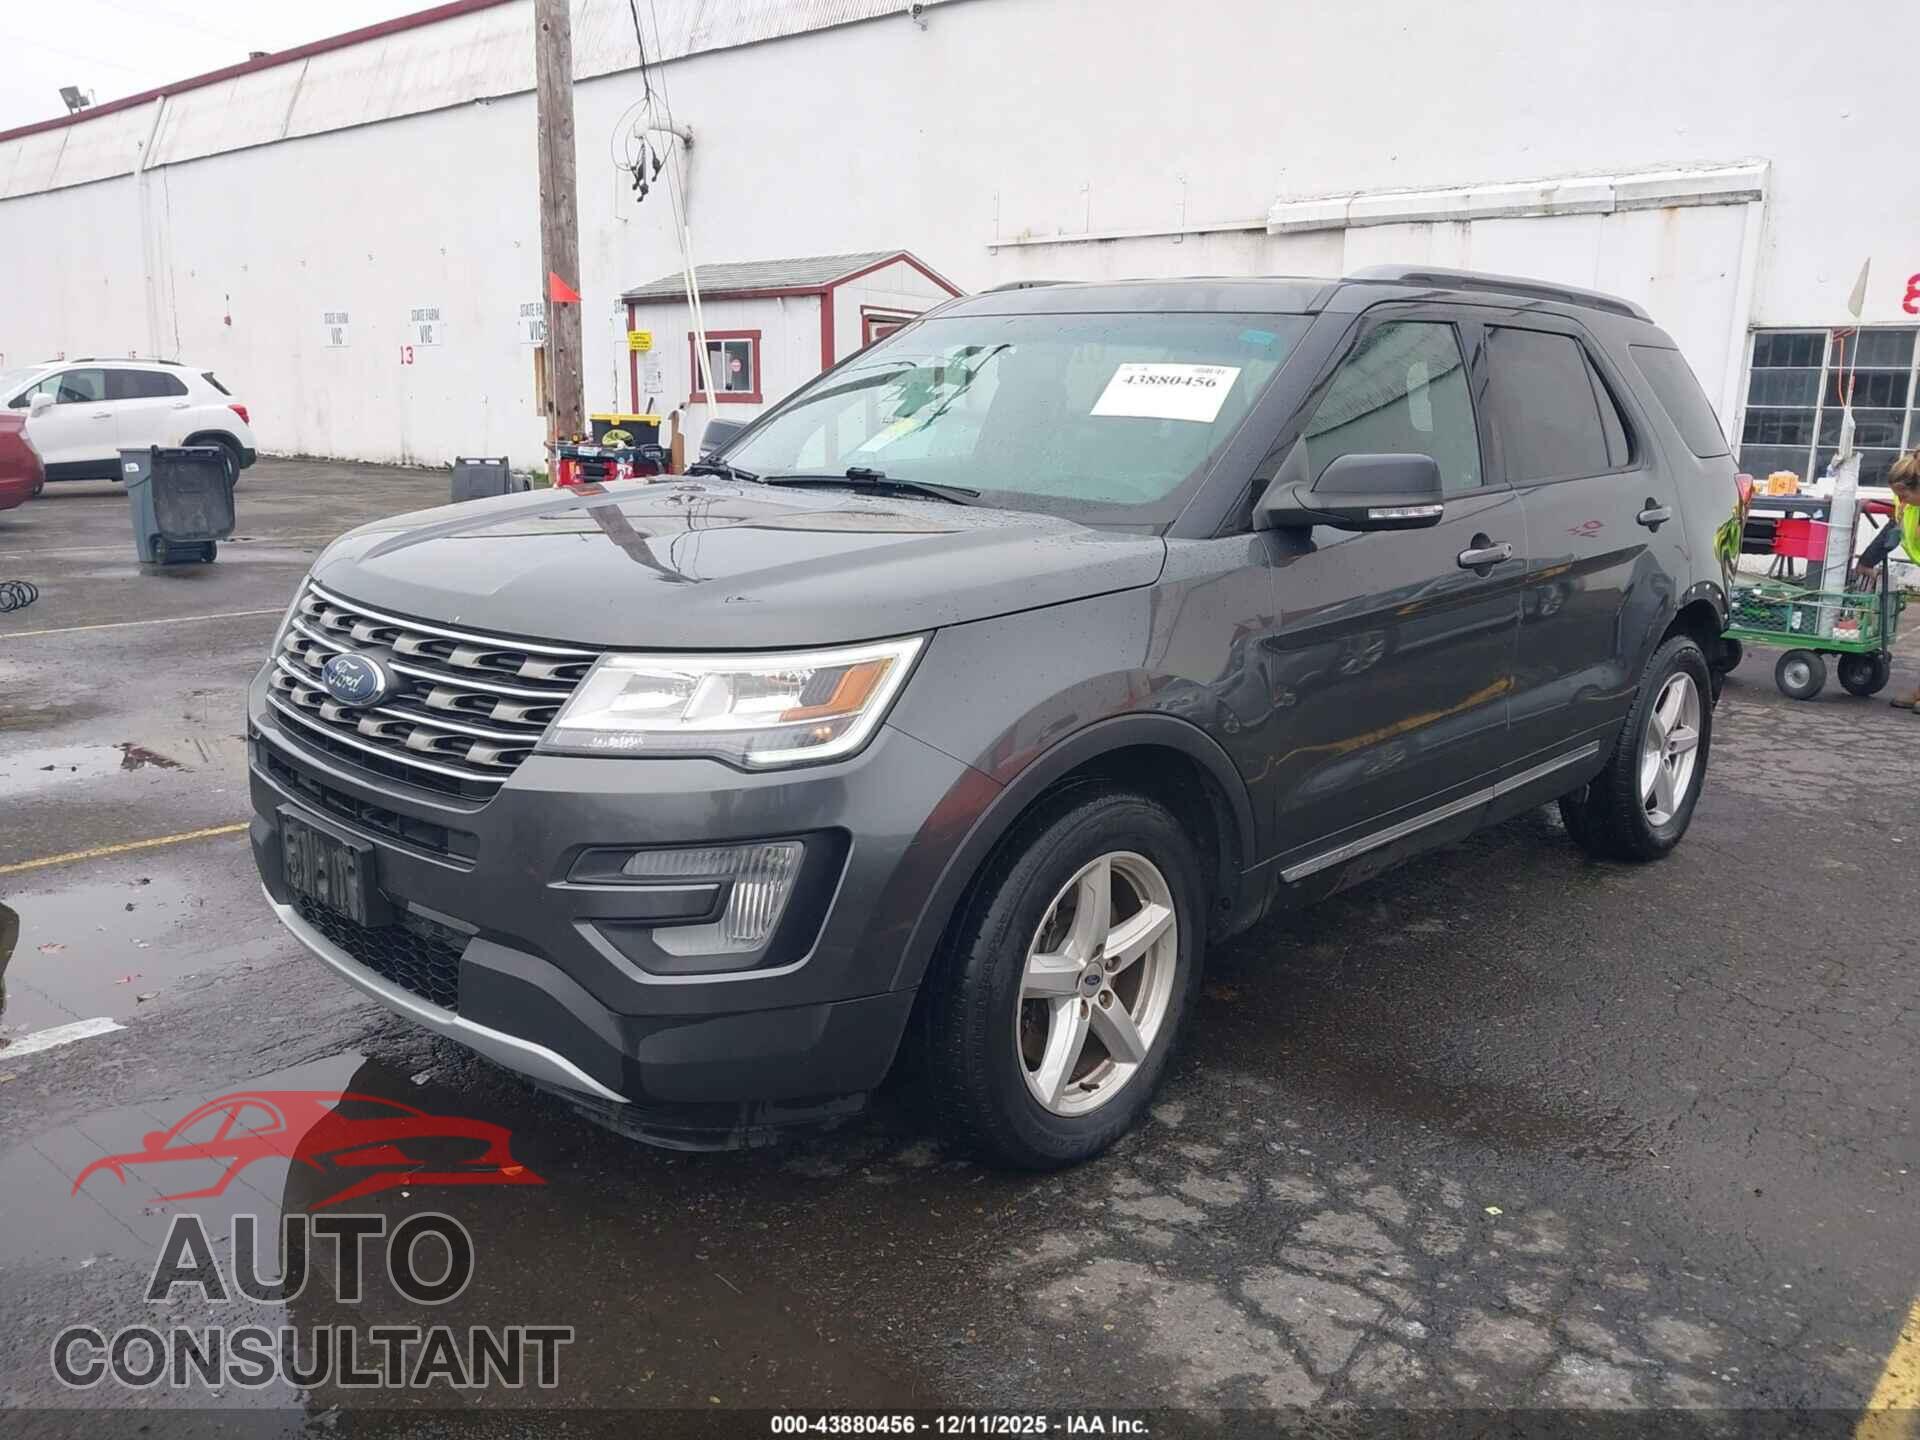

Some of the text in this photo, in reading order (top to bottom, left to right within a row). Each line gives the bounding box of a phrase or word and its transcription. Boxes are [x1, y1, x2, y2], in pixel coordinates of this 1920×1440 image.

[400, 346, 414, 365] 13
[1121, 375, 1217, 388] 43880456
[328, 660, 365, 692] Ford
